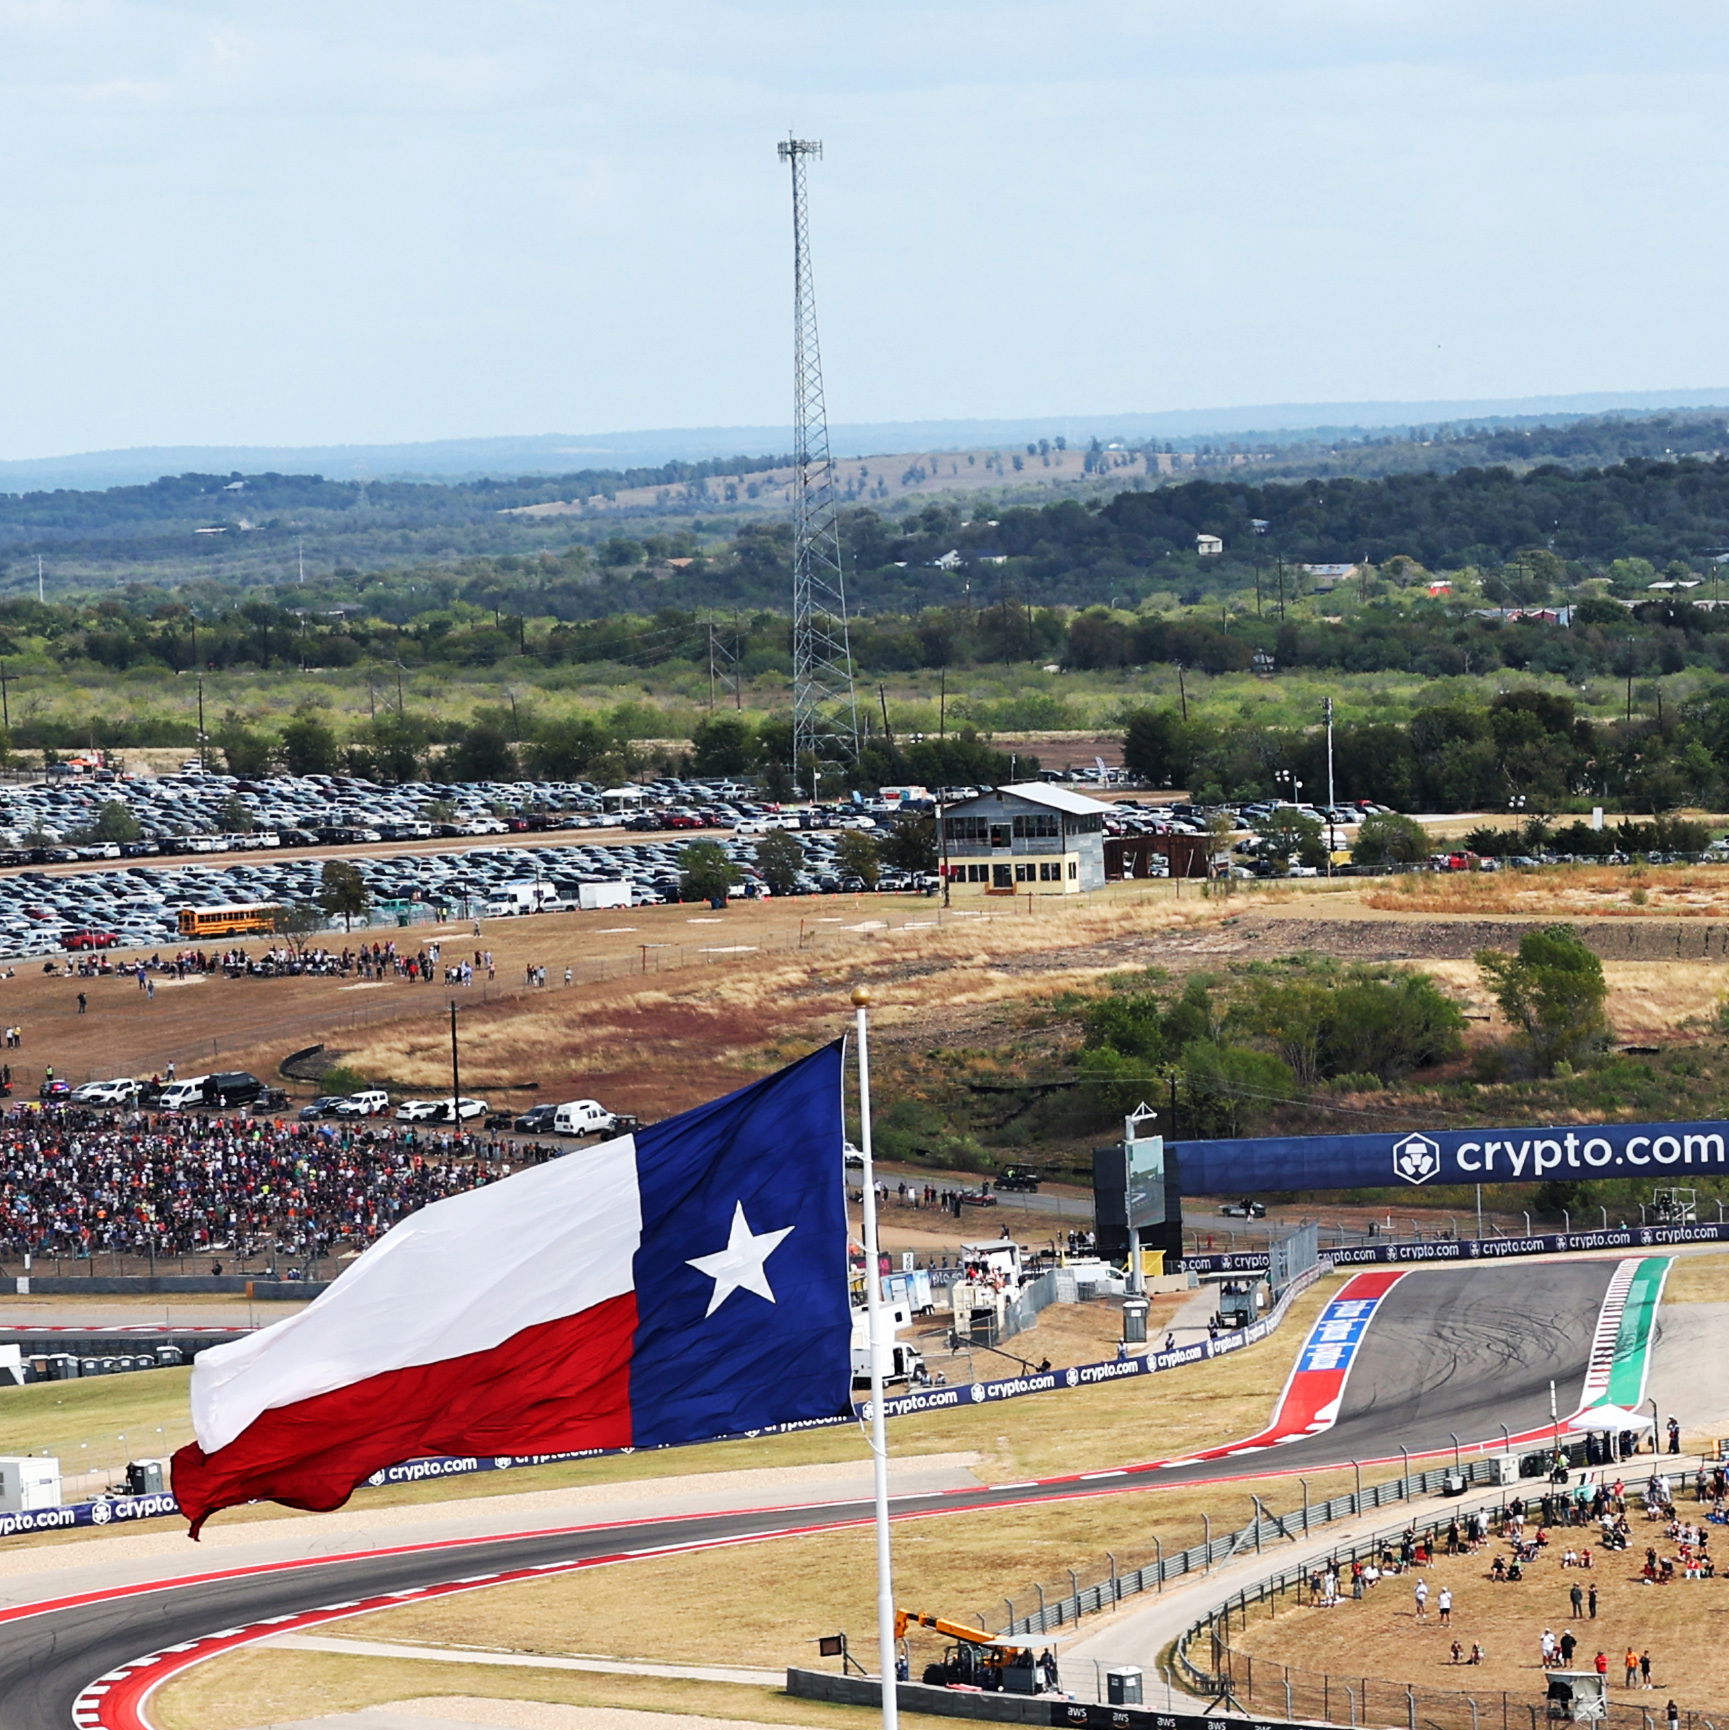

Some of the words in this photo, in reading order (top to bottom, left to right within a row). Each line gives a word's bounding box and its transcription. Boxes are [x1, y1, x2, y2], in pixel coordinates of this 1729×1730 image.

[1455, 1132, 1725, 1177] crypto.com
[1569, 1231, 1631, 1250] crypto.com
[1655, 1226, 1718, 1245] crypto.com
[1400, 1244, 1459, 1262] crypto.com
[1483, 1239, 1544, 1257] crypto.com
[1158, 1345, 1202, 1369] crypto.com
[1080, 1359, 1138, 1385] crypto.com
[987, 1374, 1055, 1399] crypto.com
[388, 1455, 477, 1482] crypto.com
